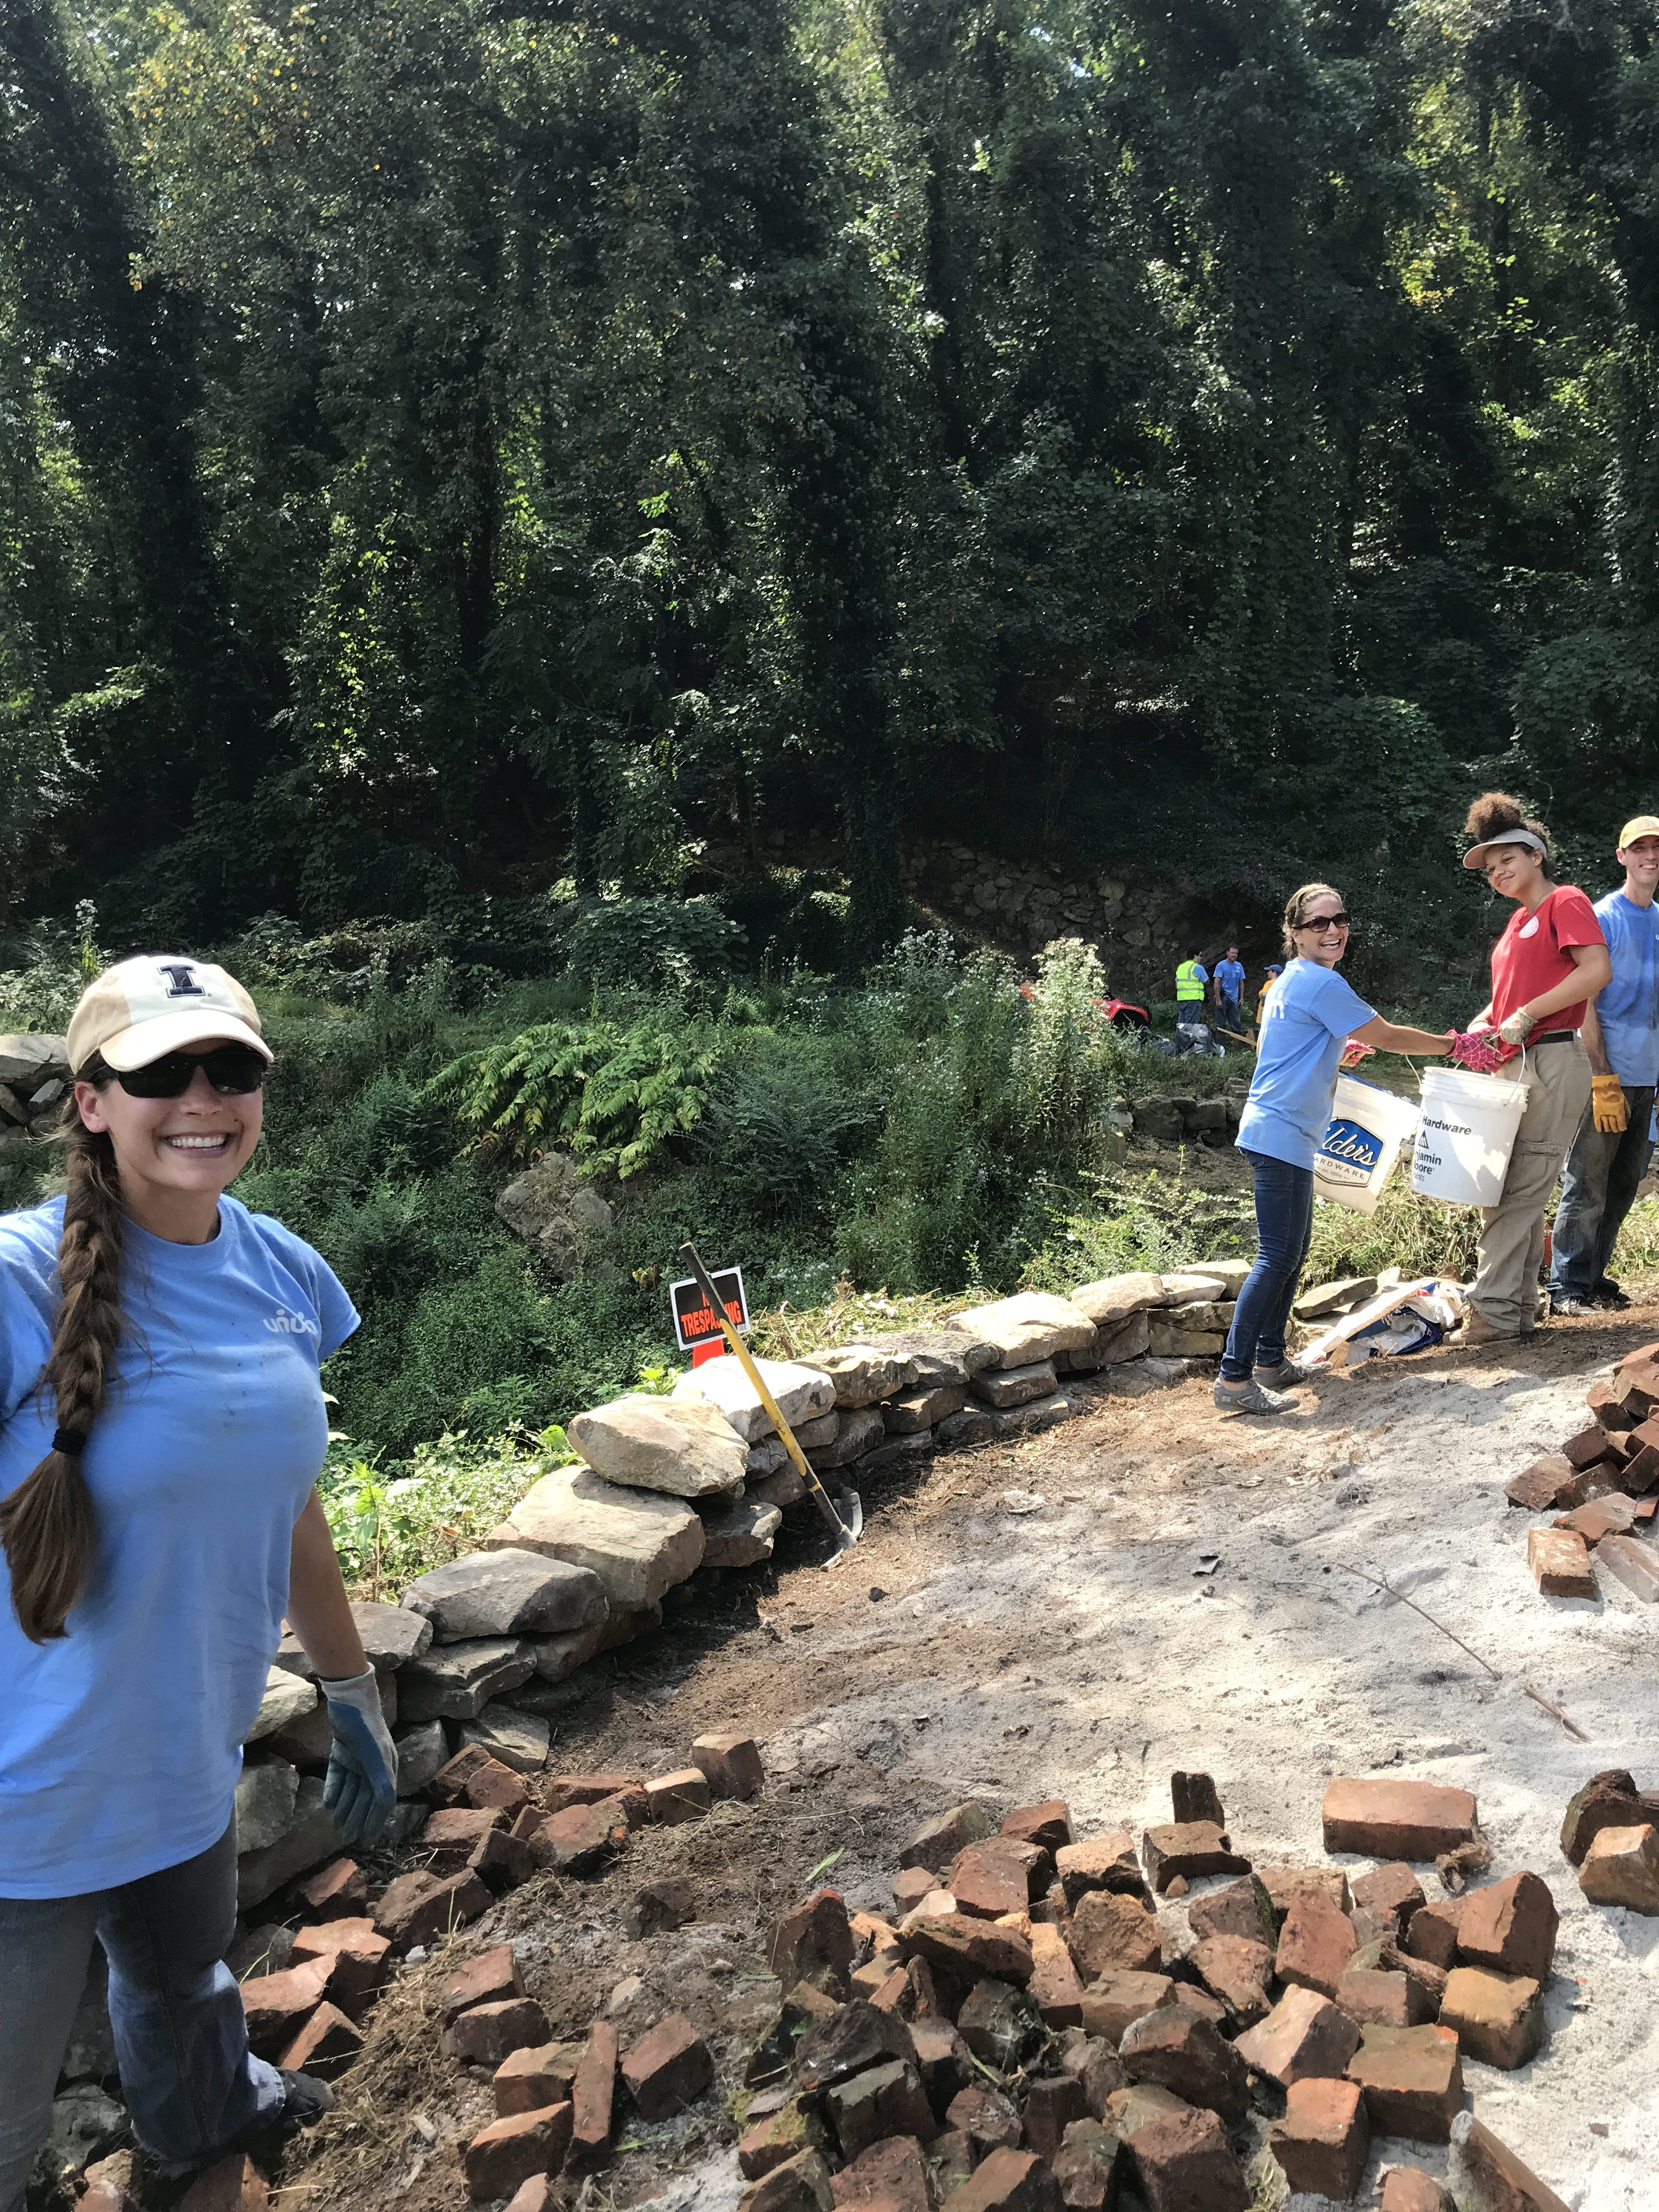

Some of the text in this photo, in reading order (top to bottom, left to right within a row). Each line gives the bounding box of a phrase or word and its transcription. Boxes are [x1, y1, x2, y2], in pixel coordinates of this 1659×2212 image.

[157, 964, 206, 998] I
[1422, 1115, 1472, 1135] Hardware
[1322, 1116, 1377, 1166] lder's
[1315, 1156, 1365, 1180] ARDWARE
[1415, 1149, 1442, 1166] njamin
[1330, 1170, 1342, 1179] 1969
